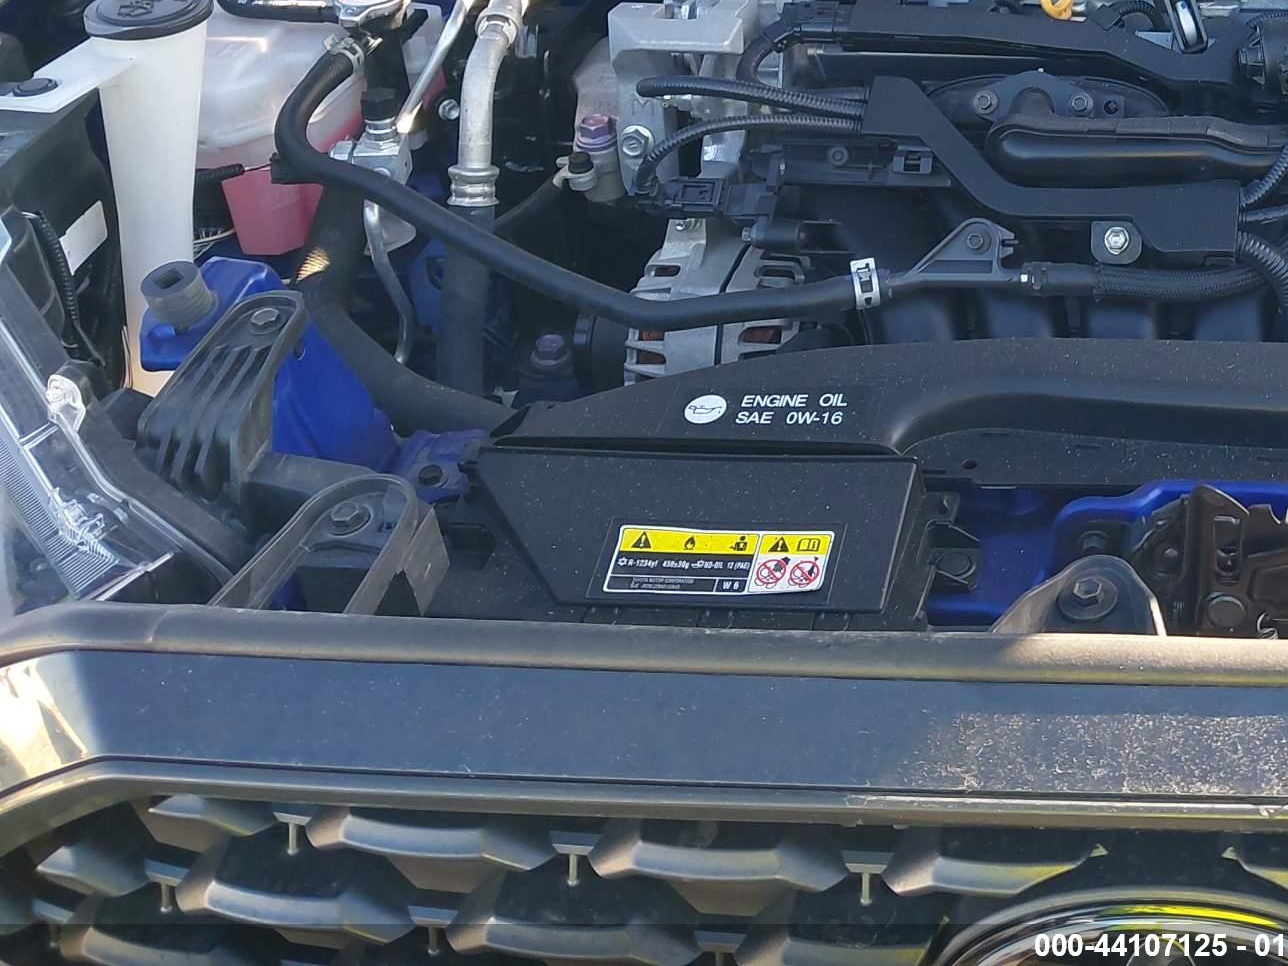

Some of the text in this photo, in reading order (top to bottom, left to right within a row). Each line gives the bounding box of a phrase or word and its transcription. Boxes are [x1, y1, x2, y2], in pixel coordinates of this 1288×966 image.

[741, 393, 847, 408] ENGINE OIL
[735, 411, 843, 425] SAE 0W-16
[722, 581, 739, 590] W 6
